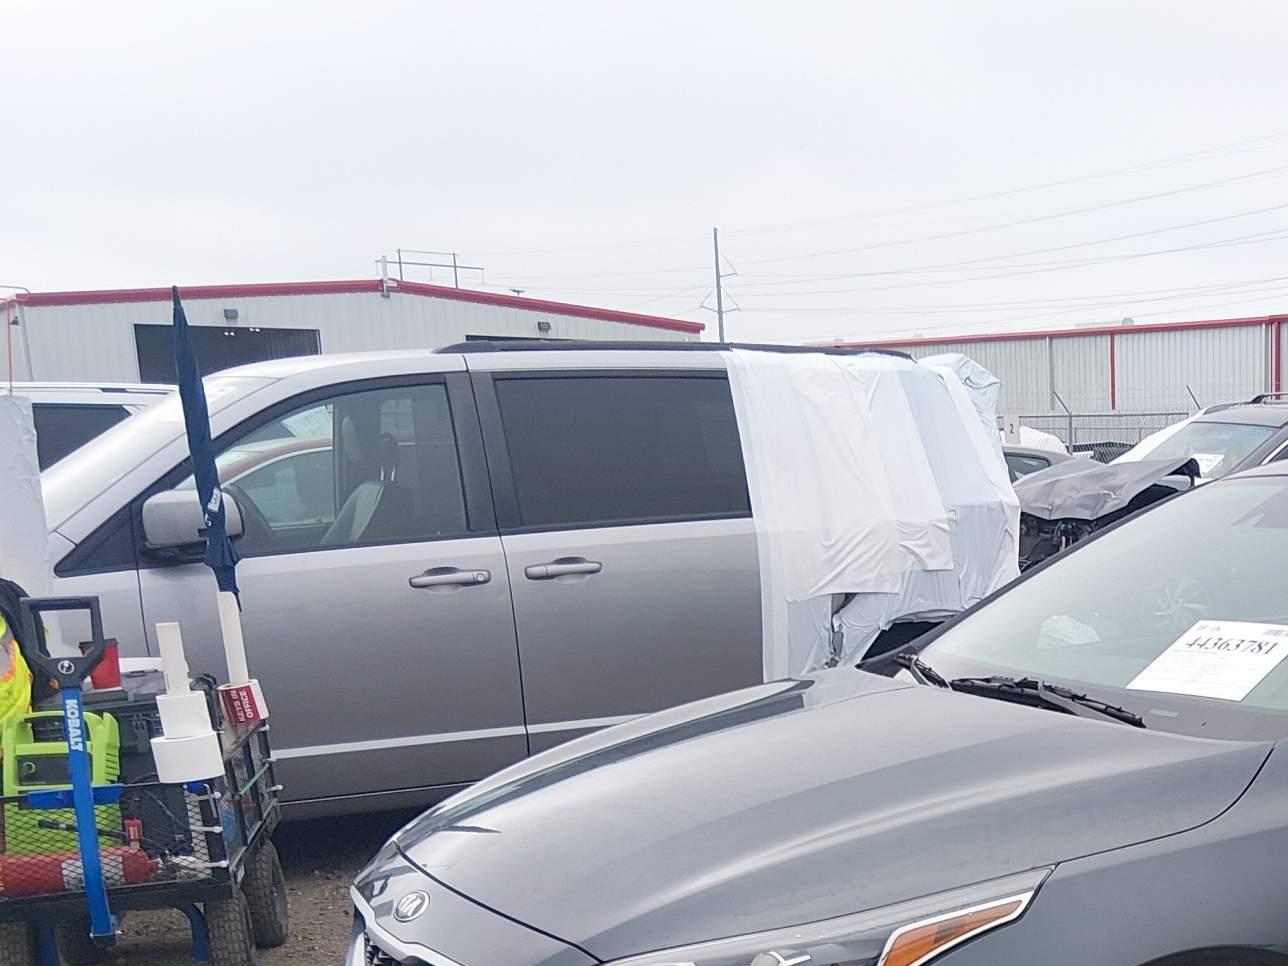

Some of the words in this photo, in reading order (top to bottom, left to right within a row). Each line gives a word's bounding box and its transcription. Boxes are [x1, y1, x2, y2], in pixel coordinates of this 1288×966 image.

[1009, 423, 1015, 434] 2
[1186, 635, 1279, 655] 44363781
[233, 700, 246, 722] KEYS
[239, 690, 254, 718] OFFICE
[65, 699, 83, 751] KOBALT
